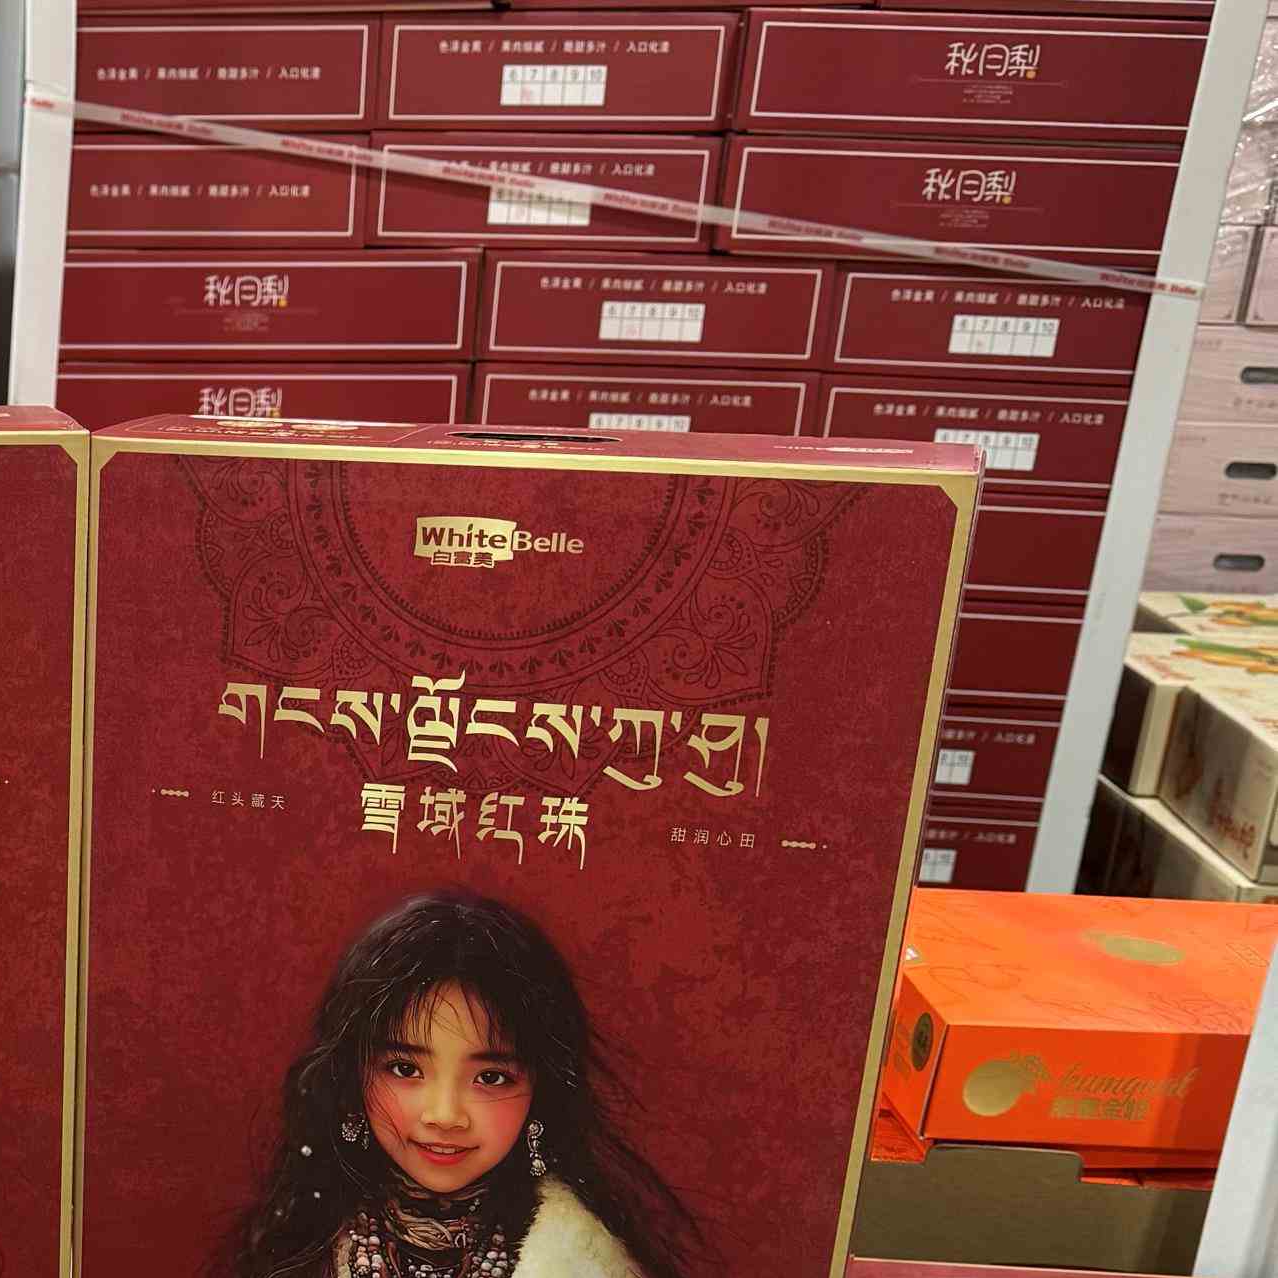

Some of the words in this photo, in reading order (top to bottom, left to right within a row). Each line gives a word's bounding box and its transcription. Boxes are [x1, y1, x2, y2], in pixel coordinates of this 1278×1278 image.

[945, 42, 1041, 78] 秋月梨
[360, 782, 589, 870] 雪域红珠
[669, 827, 755, 850] 甜润心田
